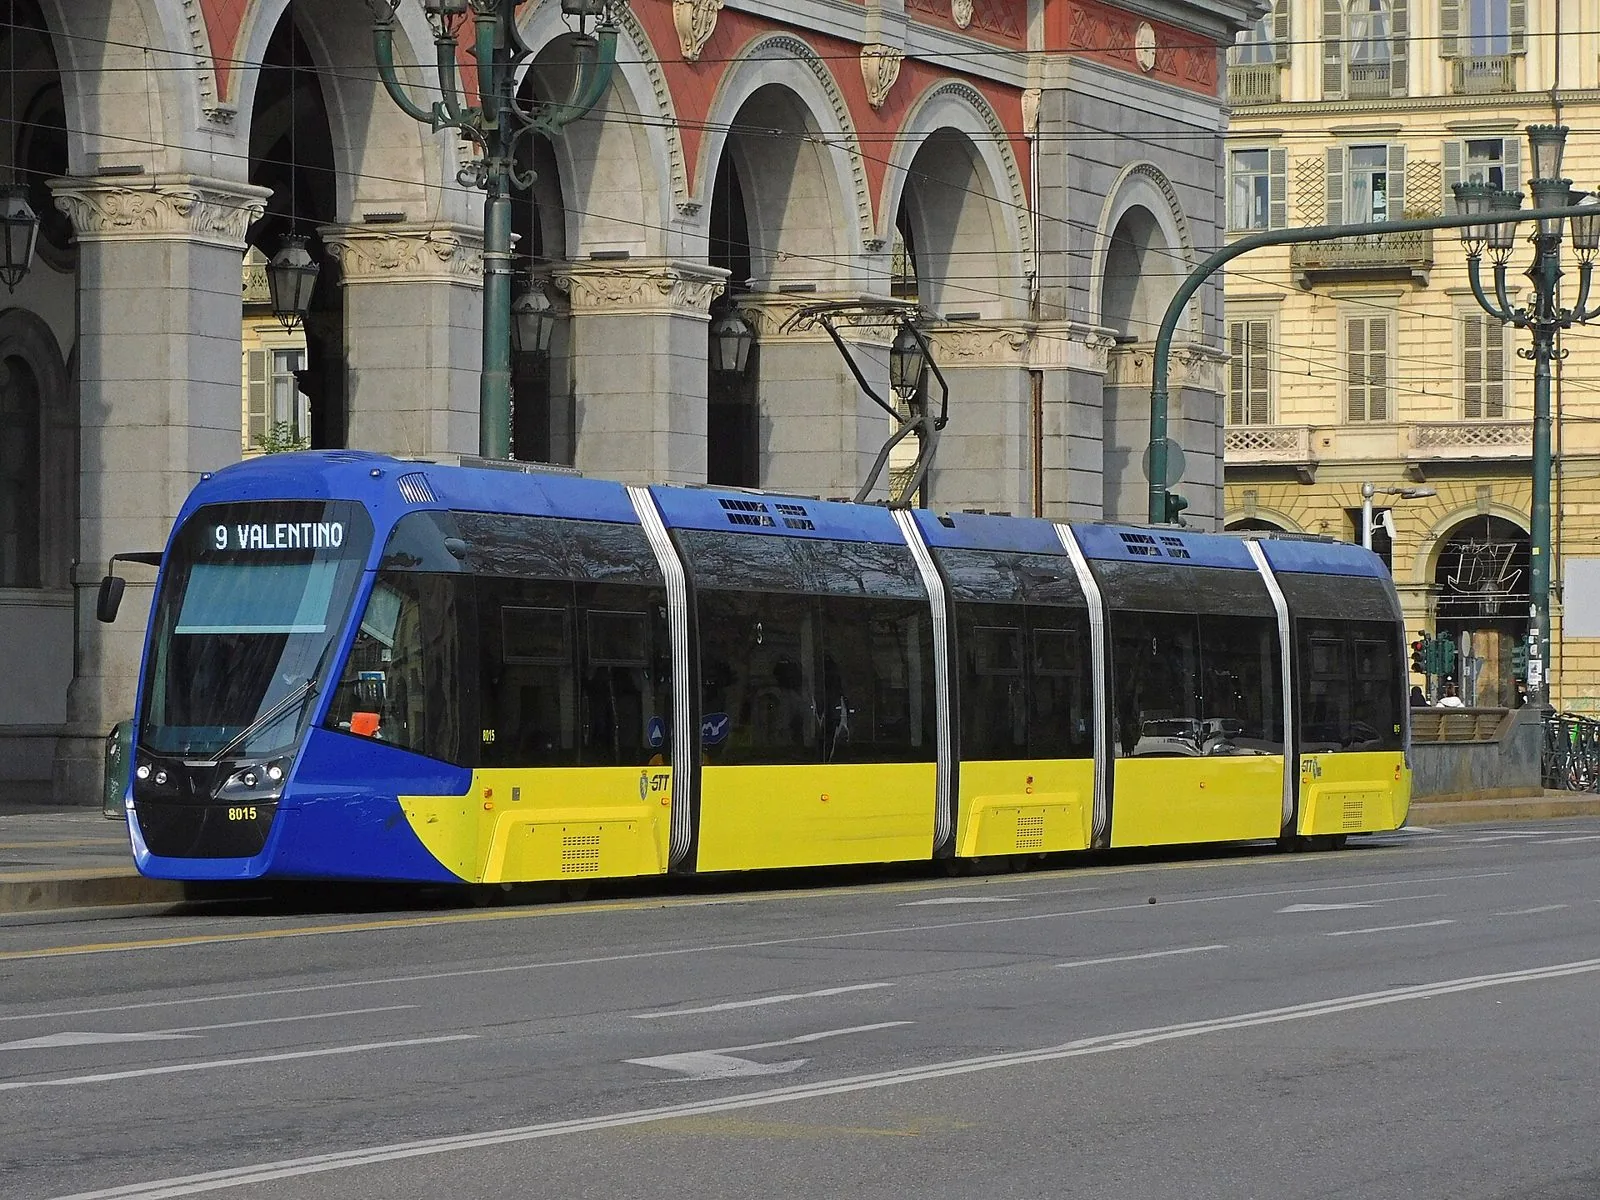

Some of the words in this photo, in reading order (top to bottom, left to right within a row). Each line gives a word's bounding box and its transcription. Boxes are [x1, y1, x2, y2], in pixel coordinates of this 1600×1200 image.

[215, 525, 228, 549] 9
[237, 522, 343, 549] VALENTINO
[228, 807, 257, 821] 8015
